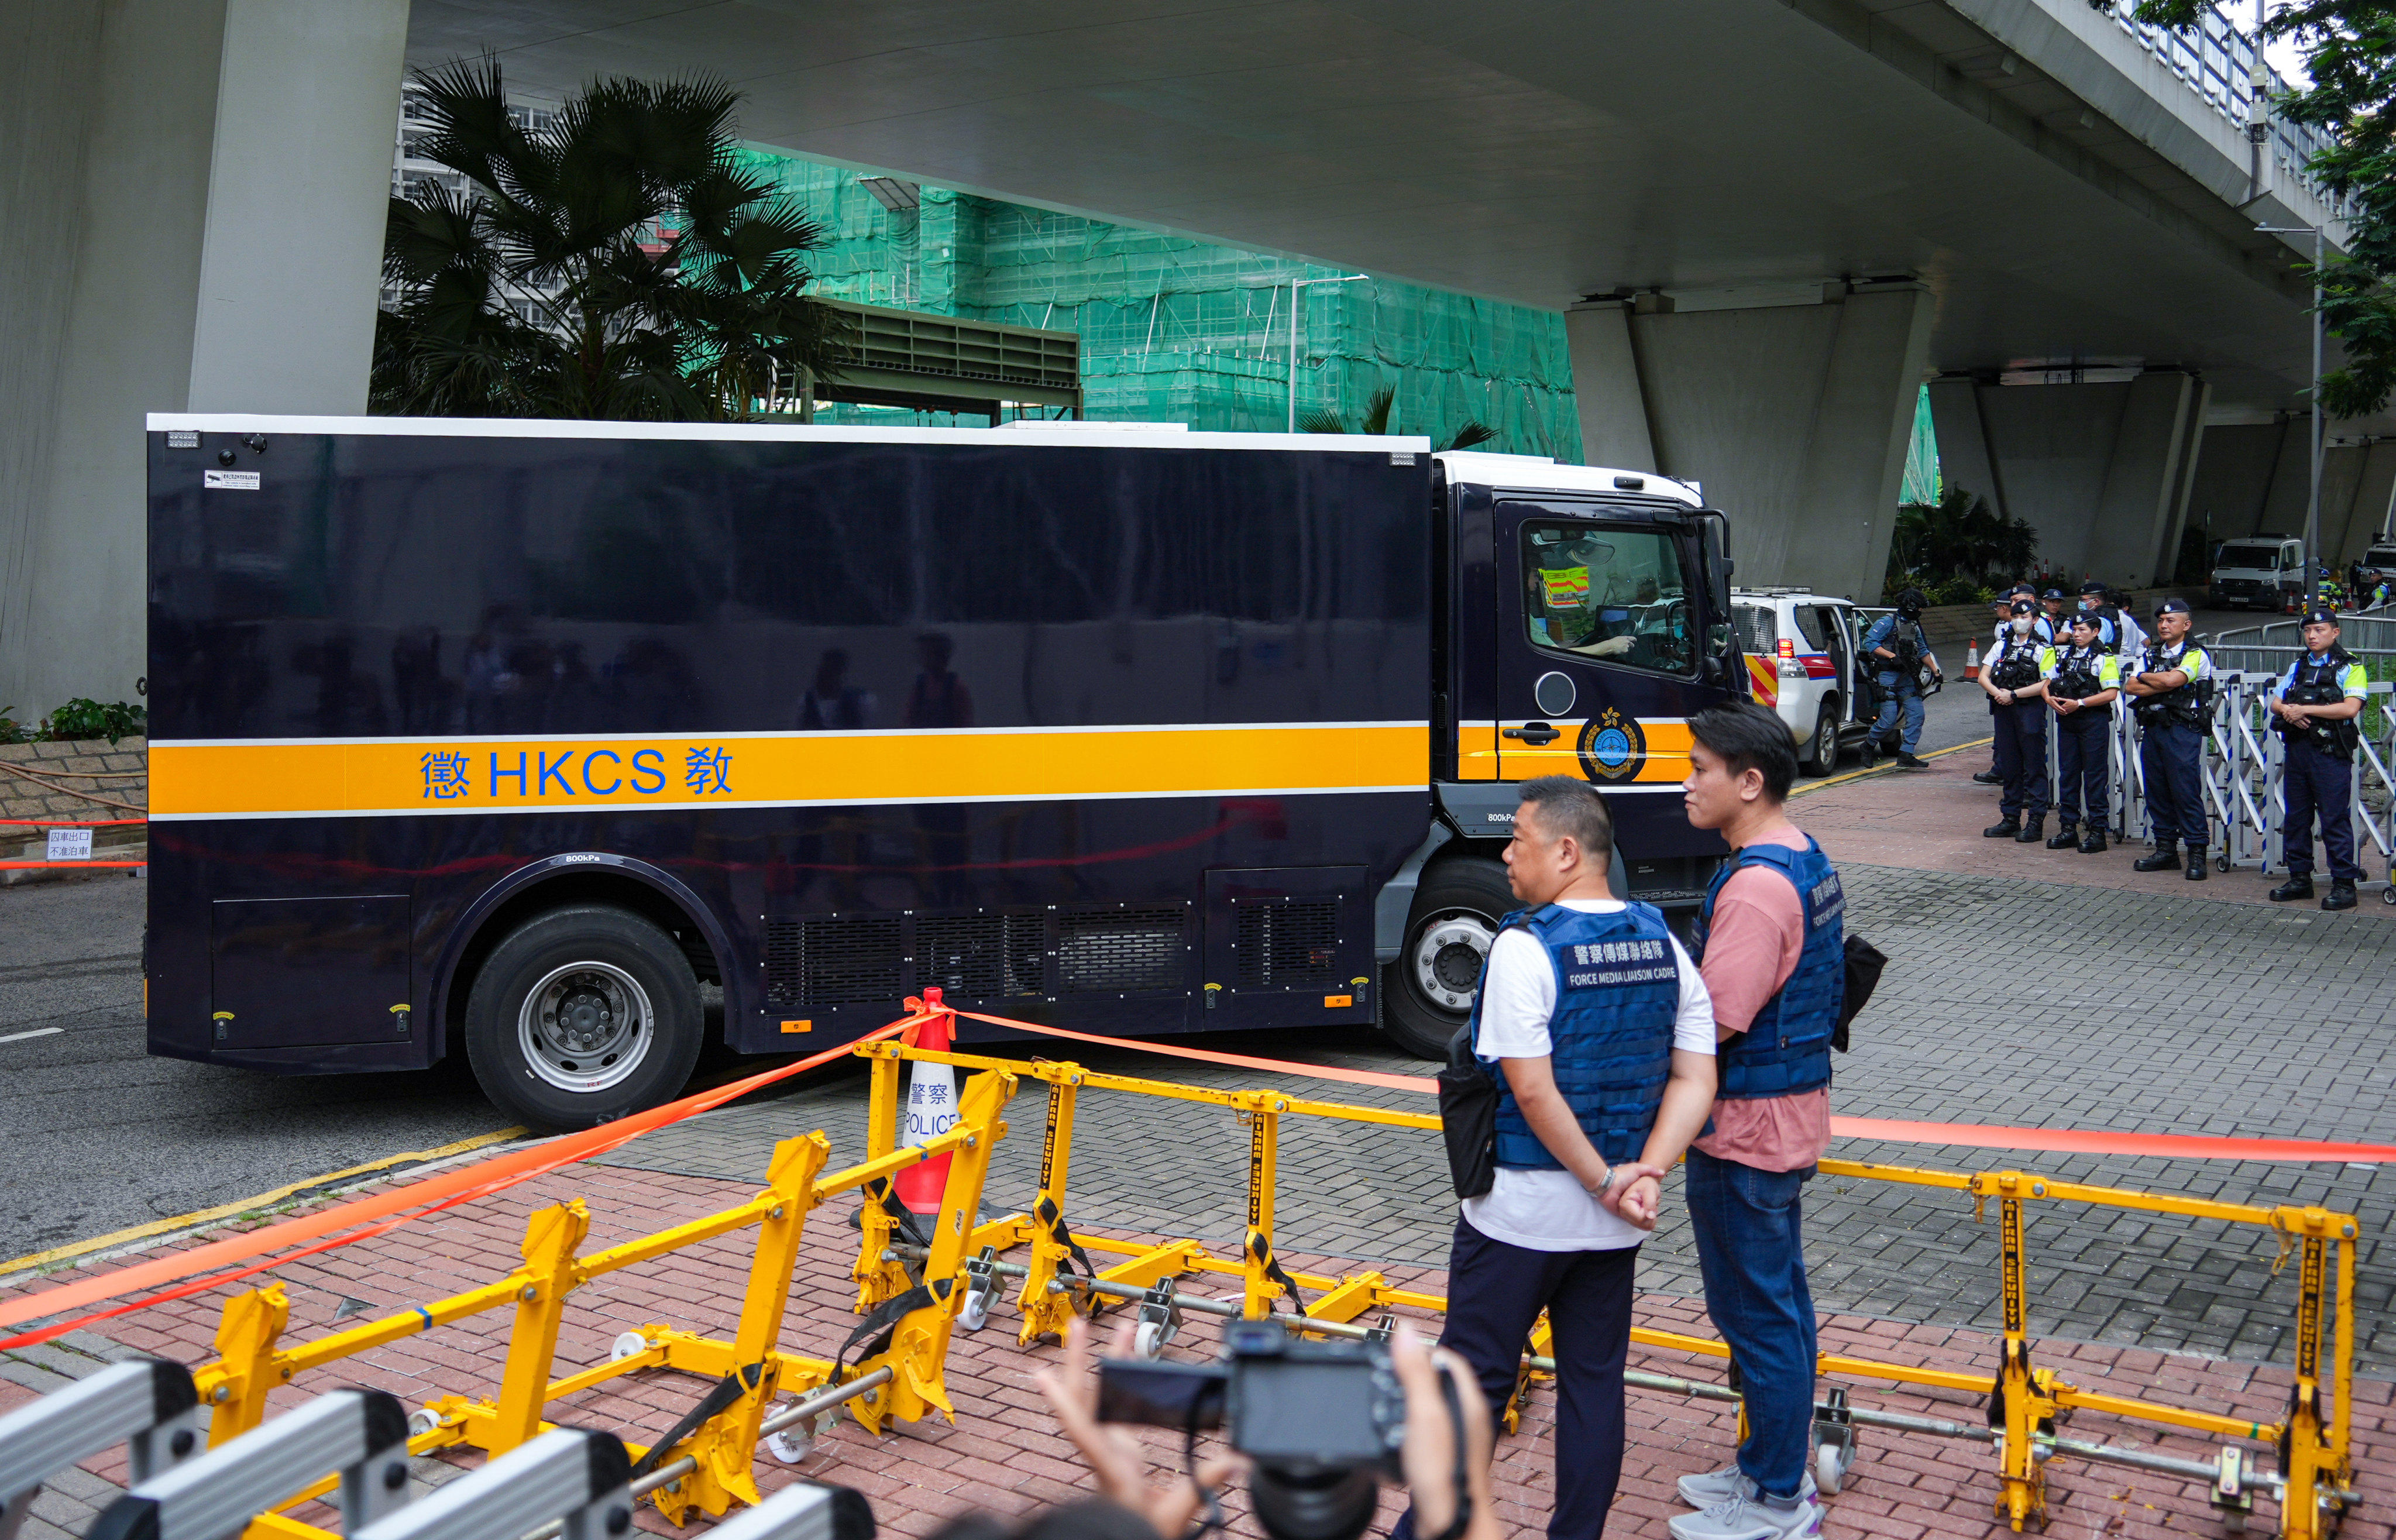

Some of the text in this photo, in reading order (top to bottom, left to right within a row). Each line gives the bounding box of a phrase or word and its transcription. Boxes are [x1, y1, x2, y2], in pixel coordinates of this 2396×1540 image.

[420, 751, 470, 799] 懲
[490, 749, 666, 796] HKCS
[1488, 813, 1515, 821] 800kPa
[51, 831, 89, 842] 囚車出口
[50, 845, 88, 857] 不准泊車
[1574, 940, 1663, 965] 警察傳媒聯絡隊
[1569, 967, 1676, 986] FORCE MEDIA LIAISON CADRE
[911, 1082, 948, 1105] 警察
[1042, 1131, 1054, 1184] SECURITY
[2006, 1259, 2017, 1324] SECURITY
